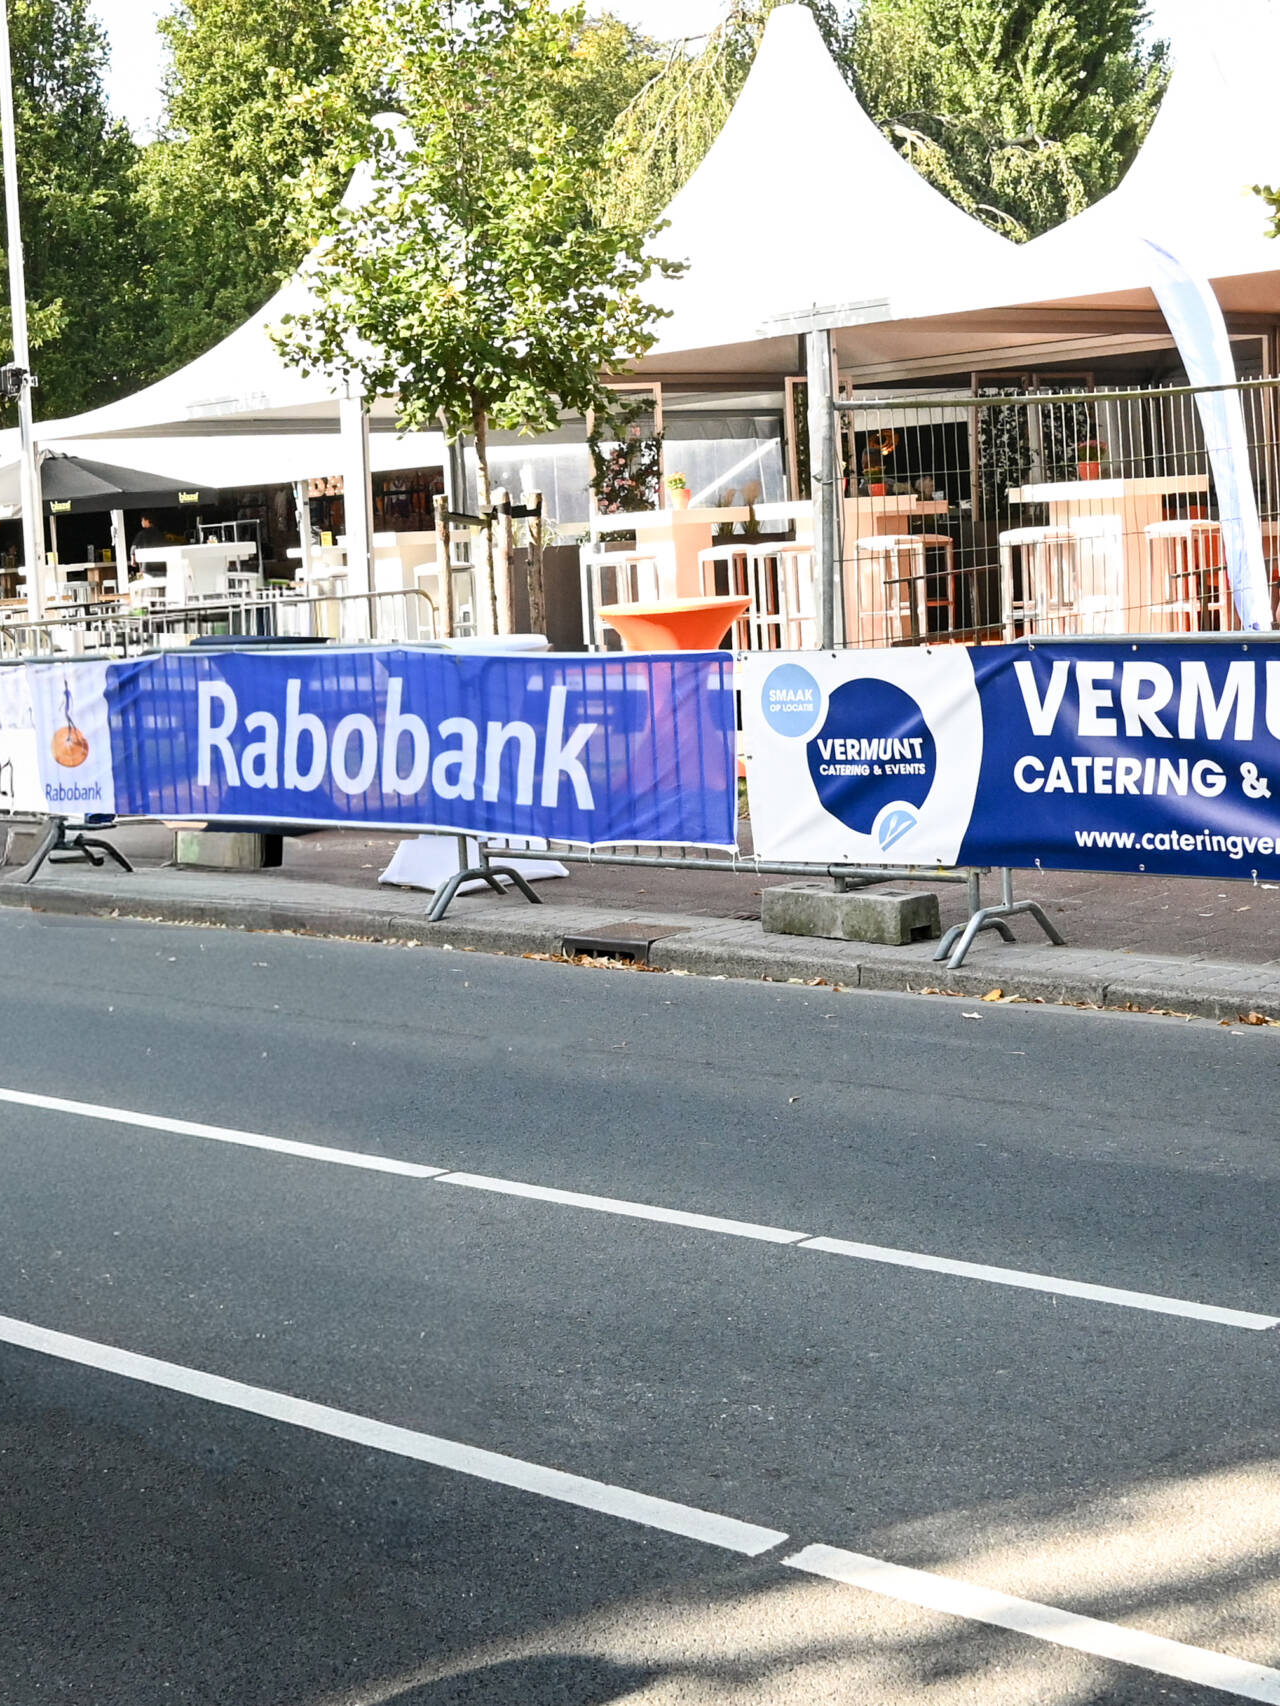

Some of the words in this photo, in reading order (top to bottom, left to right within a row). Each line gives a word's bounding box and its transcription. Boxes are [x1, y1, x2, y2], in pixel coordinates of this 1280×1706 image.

[769, 689, 813, 701] SMAAK
[770, 704, 781, 712] OP
[783, 703, 814, 712] LOCATIE
[197, 677, 598, 811] Rabobank
[817, 738, 924, 760] VERMUNT
[820, 764, 870, 775] CATERING
[873, 764, 883, 775] &
[885, 763, 926, 775] EVENTS
[1014, 755, 1227, 798] CATERING
[1241, 762, 1271, 798] &
[45, 782, 102, 801] Rabobank
